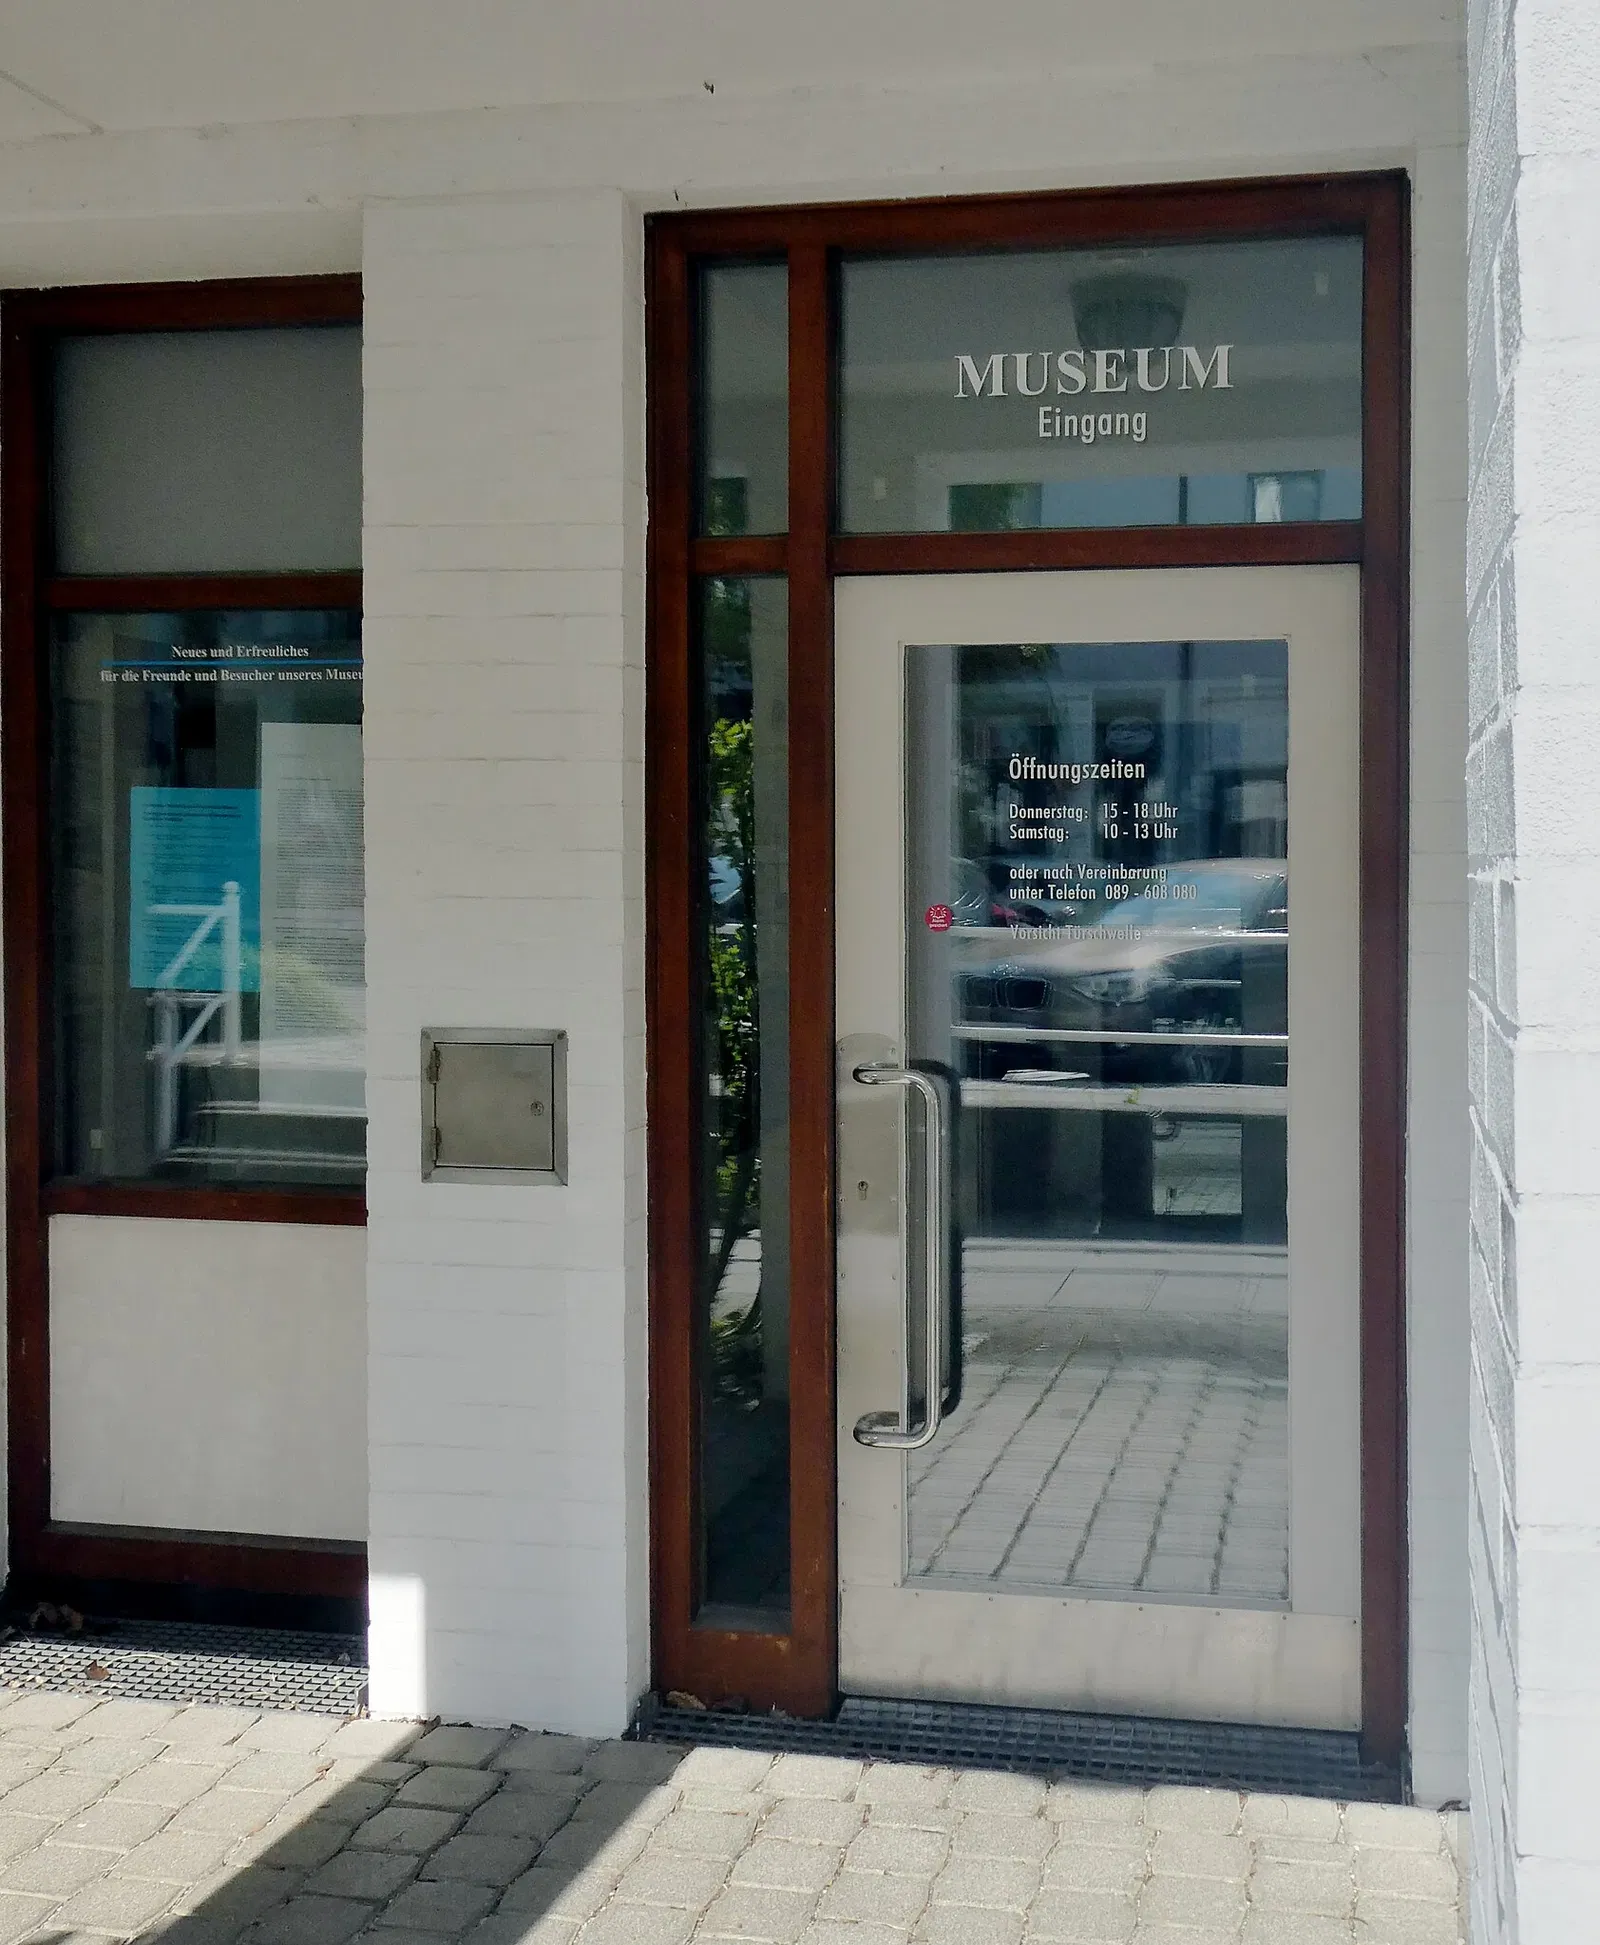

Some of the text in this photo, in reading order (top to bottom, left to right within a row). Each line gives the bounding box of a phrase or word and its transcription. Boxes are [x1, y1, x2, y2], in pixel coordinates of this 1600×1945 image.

[954, 344, 1235, 398] MUSEUM
[1038, 406, 1148, 444] Eingang
[171, 645, 309, 658] Neues und Erfreuliches
[100, 669, 119, 682] für
[121, 669, 140, 682] die
[142, 669, 192, 682] Freunde
[194, 669, 217, 681] und
[220, 669, 275, 681] Besucher
[278, 669, 322, 680] unseres
[1008, 752, 1146, 785] Öffnungszeiten
[1009, 803, 1089, 822] Donnerstag:
[1103, 802, 1119, 819] 15
[1133, 802, 1150, 819] 18
[1153, 802, 1179, 819] Uhr
[1009, 823, 1070, 843] Samstag:
[1103, 823, 1119, 840] 10
[1133, 823, 1150, 840] 13
[1153, 822, 1179, 840] Uhr
[1009, 863, 1168, 883] oder nach Vereinbarung
[1009, 886, 1044, 900] unter
[1047, 884, 1097, 900] Telefon
[1104, 884, 1129, 900] 089
[1143, 884, 1168, 900] 608
[1172, 884, 1197, 900] 080
[1010, 924, 1142, 942] Vorsicht Türschwelle
